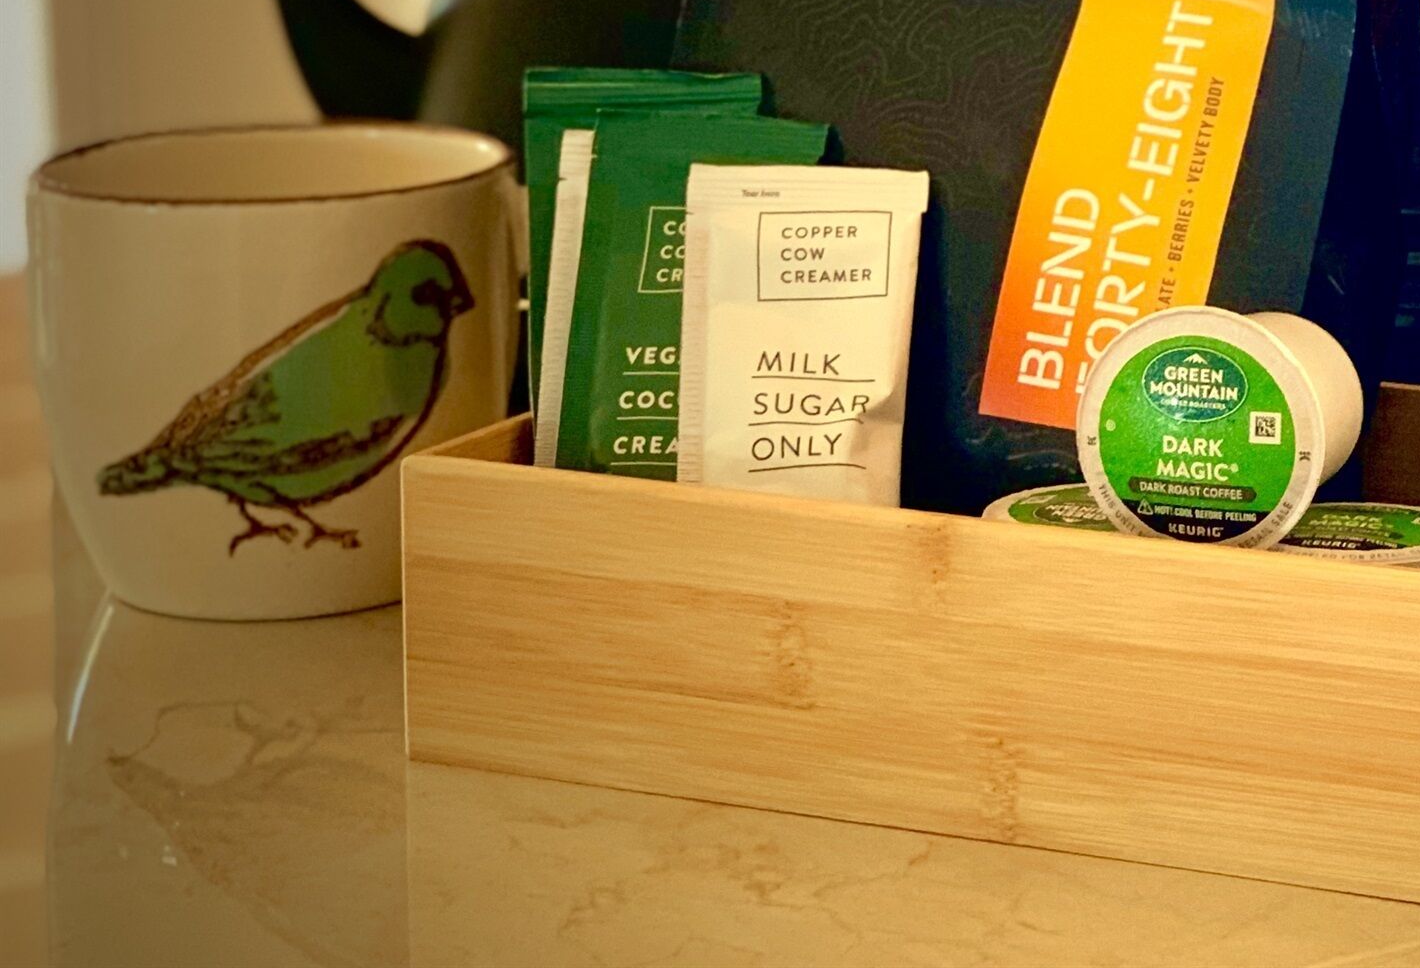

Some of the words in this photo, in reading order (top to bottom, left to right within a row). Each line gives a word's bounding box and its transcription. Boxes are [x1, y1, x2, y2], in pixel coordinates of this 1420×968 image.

[1167, 199, 1195, 263] BERRIES
[1186, 120, 1215, 183] VELVETY
[1203, 77, 1225, 118] BODY
[781, 226, 858, 240] COPPER
[781, 248, 826, 262] COW
[780, 269, 873, 284] CREAMER
[1017, 188, 1099, 390] BLEND
[626, 346, 680, 364] VEG
[757, 351, 841, 375] MILK
[1164, 366, 1224, 384] GREEN
[619, 391, 679, 409] COC
[1150, 381, 1238, 401] MOUNTAIN
[753, 393, 870, 416] SUGAR
[751, 434, 842, 461] ONLY
[1162, 435, 1223, 457] DARK
[1140, 481, 1167, 494] DARK
[1168, 483, 1201, 497] ROAST
[1203, 486, 1243, 500] COFFEE
[1225, 511, 1257, 522] PEELING
[1168, 523, 1222, 537] KEURIG
